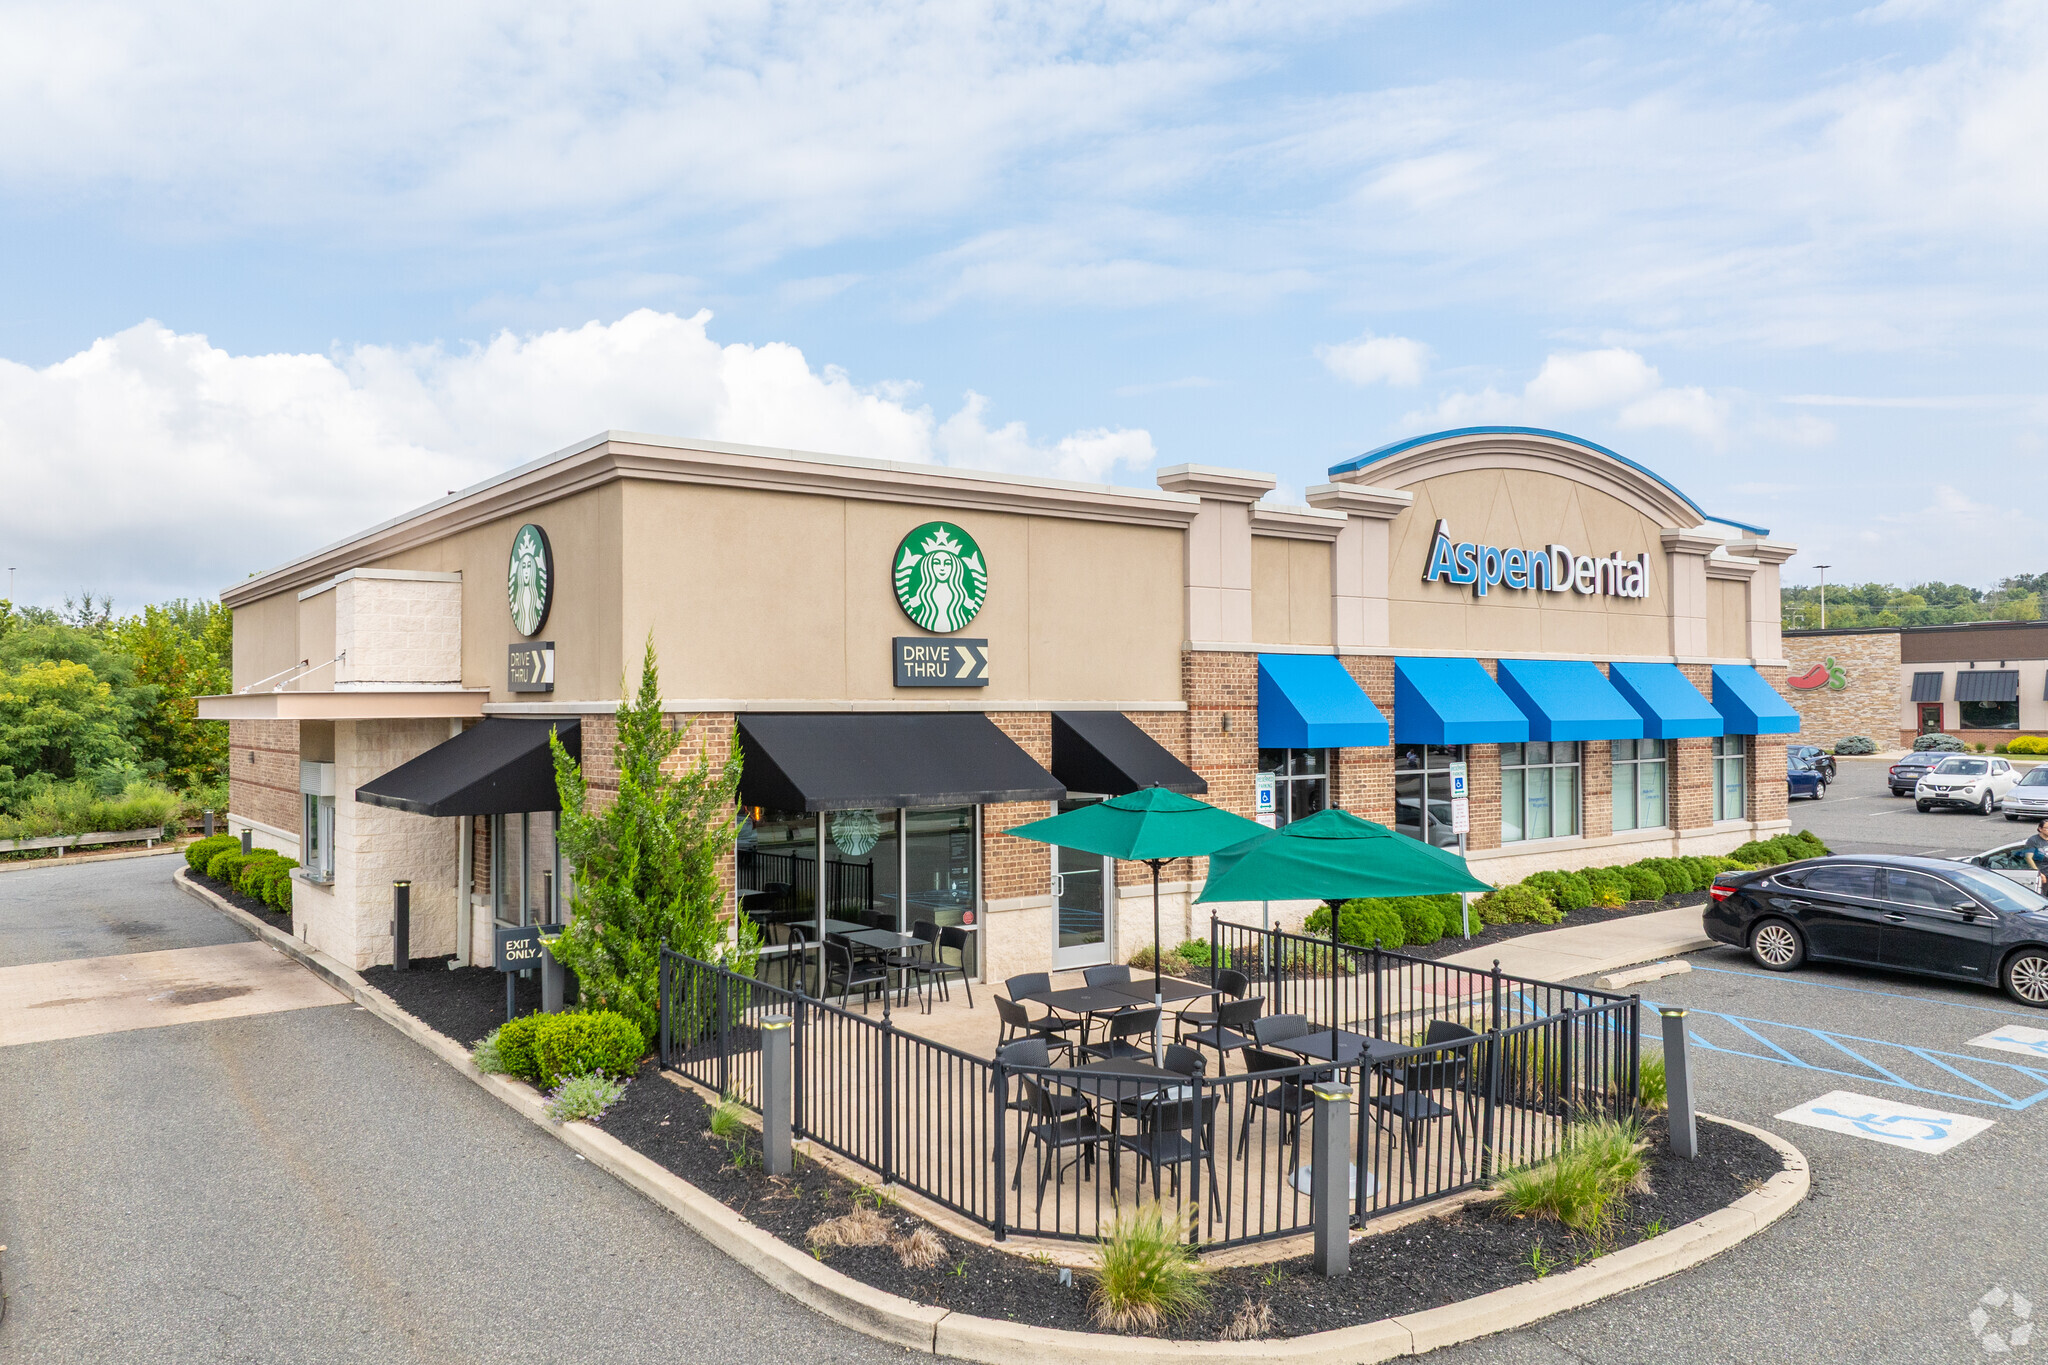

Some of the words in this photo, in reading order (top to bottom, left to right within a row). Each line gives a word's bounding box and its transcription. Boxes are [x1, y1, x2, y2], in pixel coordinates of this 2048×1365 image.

[510, 651, 530, 667] DRIVE
[903, 645, 950, 661] DRIVE
[510, 668, 529, 683] THRU
[904, 662, 947, 678] THRU
[506, 938, 531, 950] EXIT
[506, 948, 536, 961] ONLY
